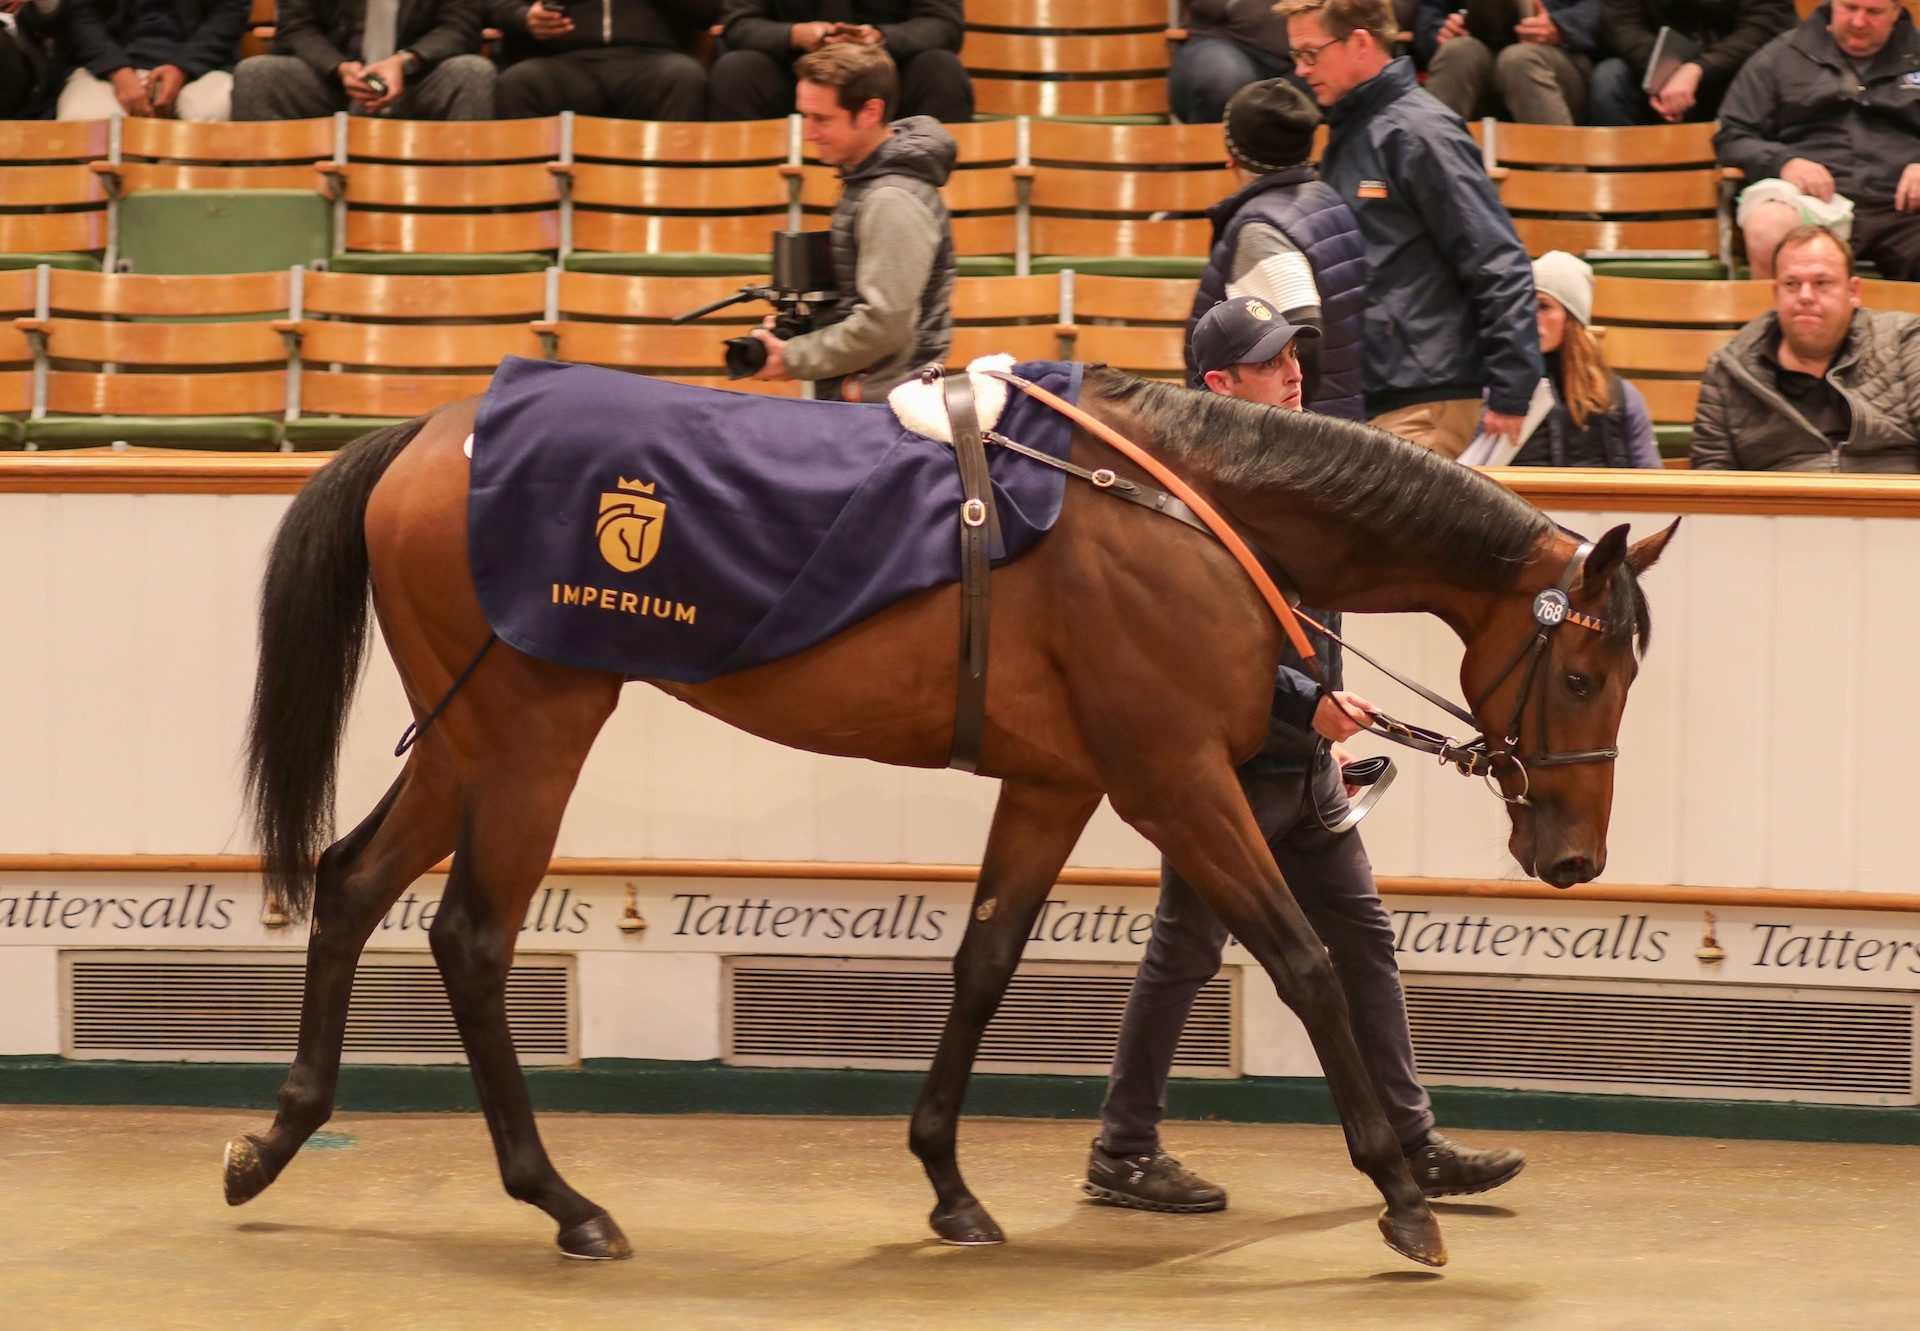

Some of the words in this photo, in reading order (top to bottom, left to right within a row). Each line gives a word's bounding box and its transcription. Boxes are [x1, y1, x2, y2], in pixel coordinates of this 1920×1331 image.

[551, 583, 697, 625] IMPERIUM
[1537, 600, 1563, 622] 768
[0, 884, 236, 930] attersalls
[382, 888, 593, 934] ttells
[672, 894, 947, 941] Tattersalls
[1393, 910, 1671, 962] Tattersalls
